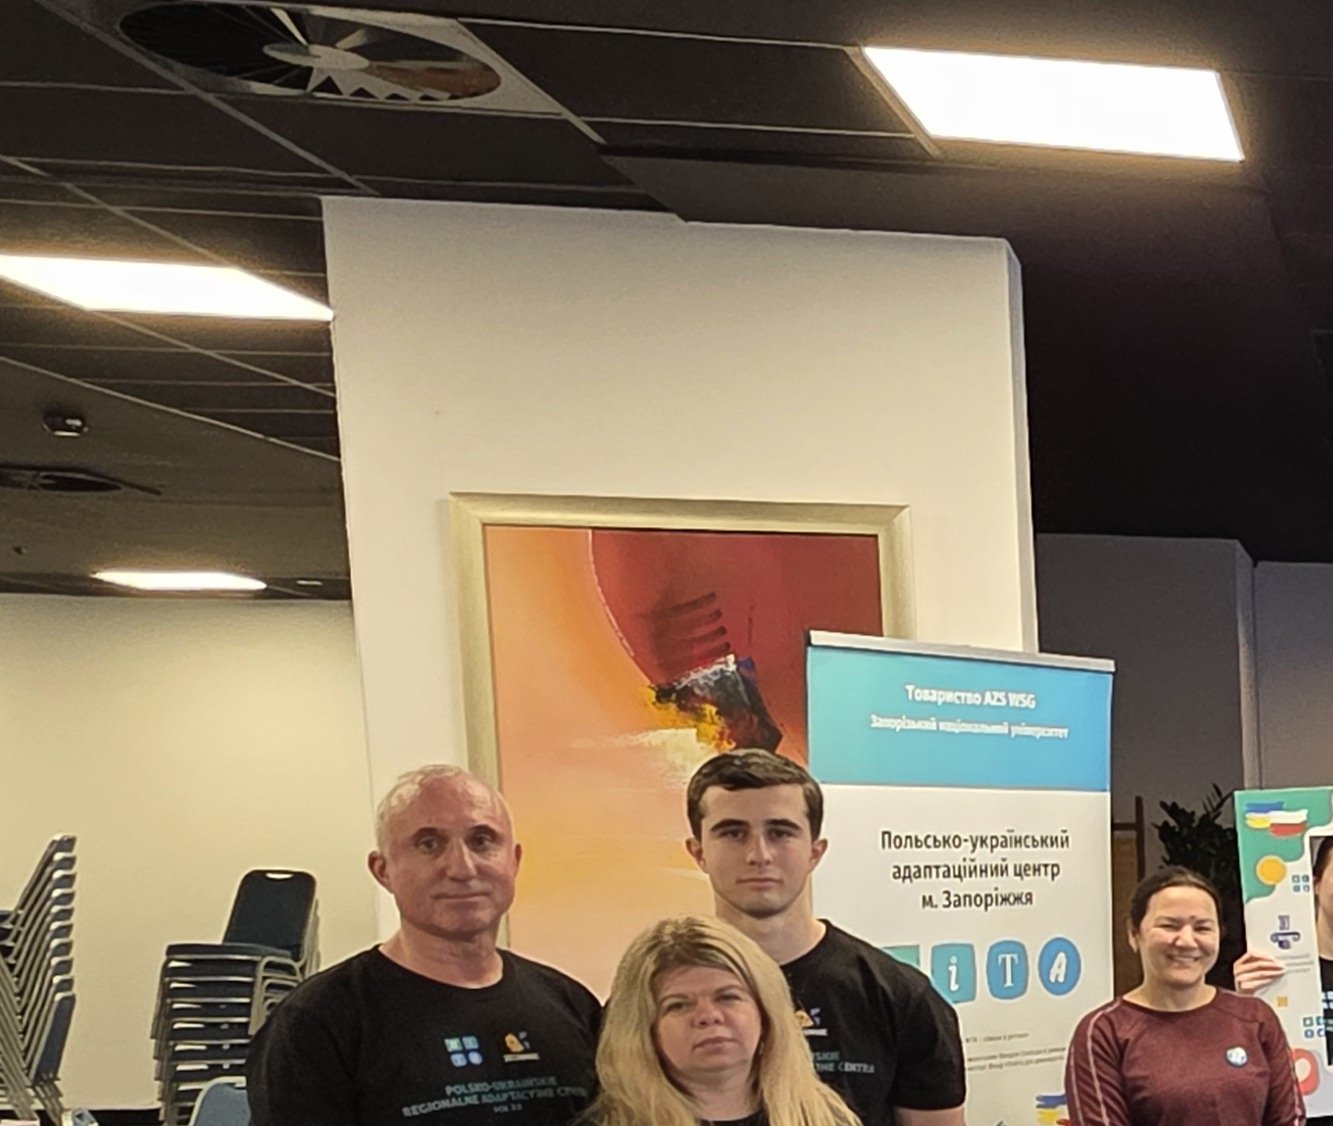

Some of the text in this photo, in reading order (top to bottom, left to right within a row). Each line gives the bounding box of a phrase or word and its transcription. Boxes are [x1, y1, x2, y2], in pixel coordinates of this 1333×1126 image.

[905, 684, 1037, 709] Товариство AZS WSG
[870, 714, 1069, 740] Запорізький національний університет
[881, 829, 1070, 853] Польсько-український
[891, 857, 1061, 883] адаптаційний центр
[921, 887, 1034, 912] м. Запоріжжя
[402, 1095, 480, 1118] REGIONALNE
